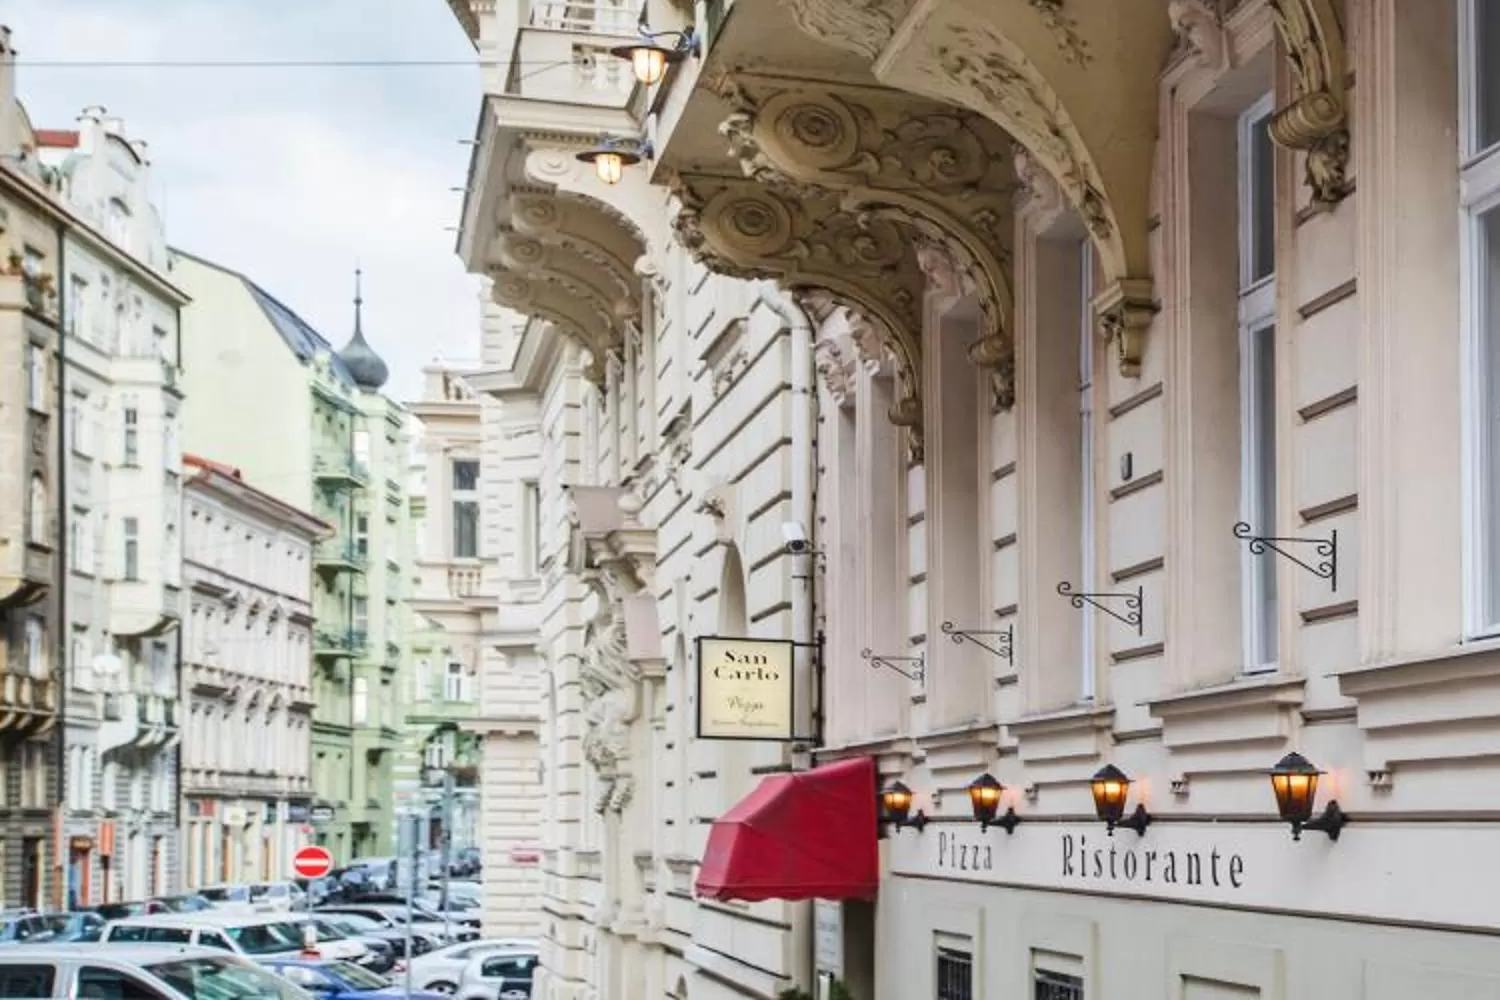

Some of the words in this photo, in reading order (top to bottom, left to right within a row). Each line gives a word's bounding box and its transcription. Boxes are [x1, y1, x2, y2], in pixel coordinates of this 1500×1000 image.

[723, 647, 768, 665] San
[713, 666, 780, 681] Carlo
[937, 830, 993, 871] Pizza
[1061, 833, 1245, 888] Ristorante
